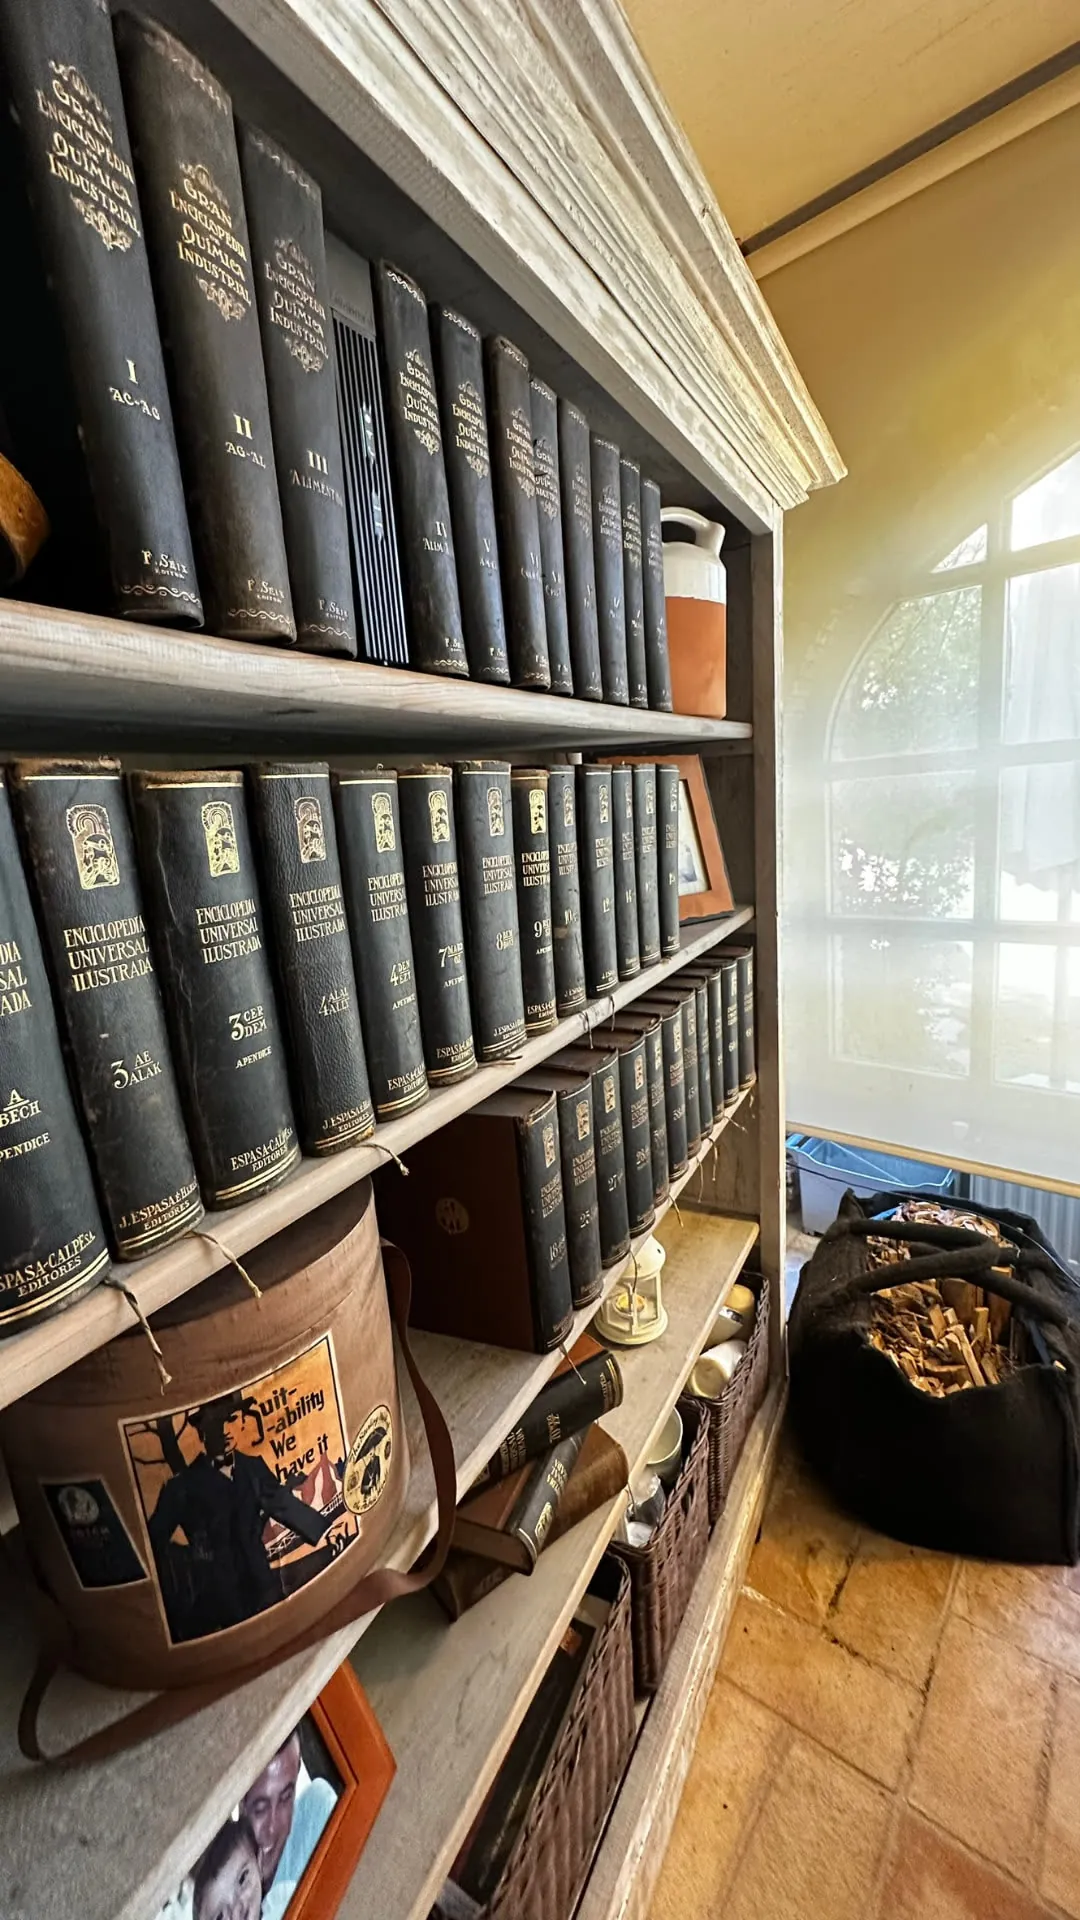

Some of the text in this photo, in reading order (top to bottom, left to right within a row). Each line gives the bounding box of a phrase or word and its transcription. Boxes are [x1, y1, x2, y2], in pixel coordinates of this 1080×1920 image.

[52, 79, 114, 144] GRAN
[183, 178, 233, 229] GRAN
[176, 240, 252, 307] INDUSTRIAL
[275, 251, 316, 294] GRAN
[125, 359, 139, 385] I
[232, 412, 254, 440] II
[307, 449, 329, 476] III
[289, 883, 342, 909] ENCICLOPEDIA
[195, 898, 257, 926] ENCICLOPEDIA
[292, 901, 344, 926] UNIVERSAL
[63, 914, 147, 949] ENCICLOPEDIA
[200, 916, 259, 945] UNIVERSAL
[295, 917, 346, 942] ILUSTRADA
[496, 932, 504, 951] 8
[534, 920, 543, 938] 9
[67, 935, 150, 970] UNIVERSAL
[201, 935, 262, 964] ILUSTRADA
[438, 946, 448, 968] 7
[71, 956, 154, 993] ILUSTRADA
[389, 964, 400, 987] 4
[228, 1012, 245, 1041] 3
[243, 1005, 264, 1021] CER
[235, 1045, 272, 1069] APENDICE
[110, 1060, 129, 1089] 3
[129, 1061, 163, 1086] ALAK
[8, 1089, 25, 1106] A
[0, 1132, 51, 1163] PENDICE
[131, 1194, 176, 1225] ESPASA
[143, 1199, 190, 1232] EDITORES
[18, 1255, 83, 1298] EDITORES
[266, 1389, 325, 1434] -ability
[269, 1432, 297, 1460] We
[275, 1433, 329, 1483] have it
